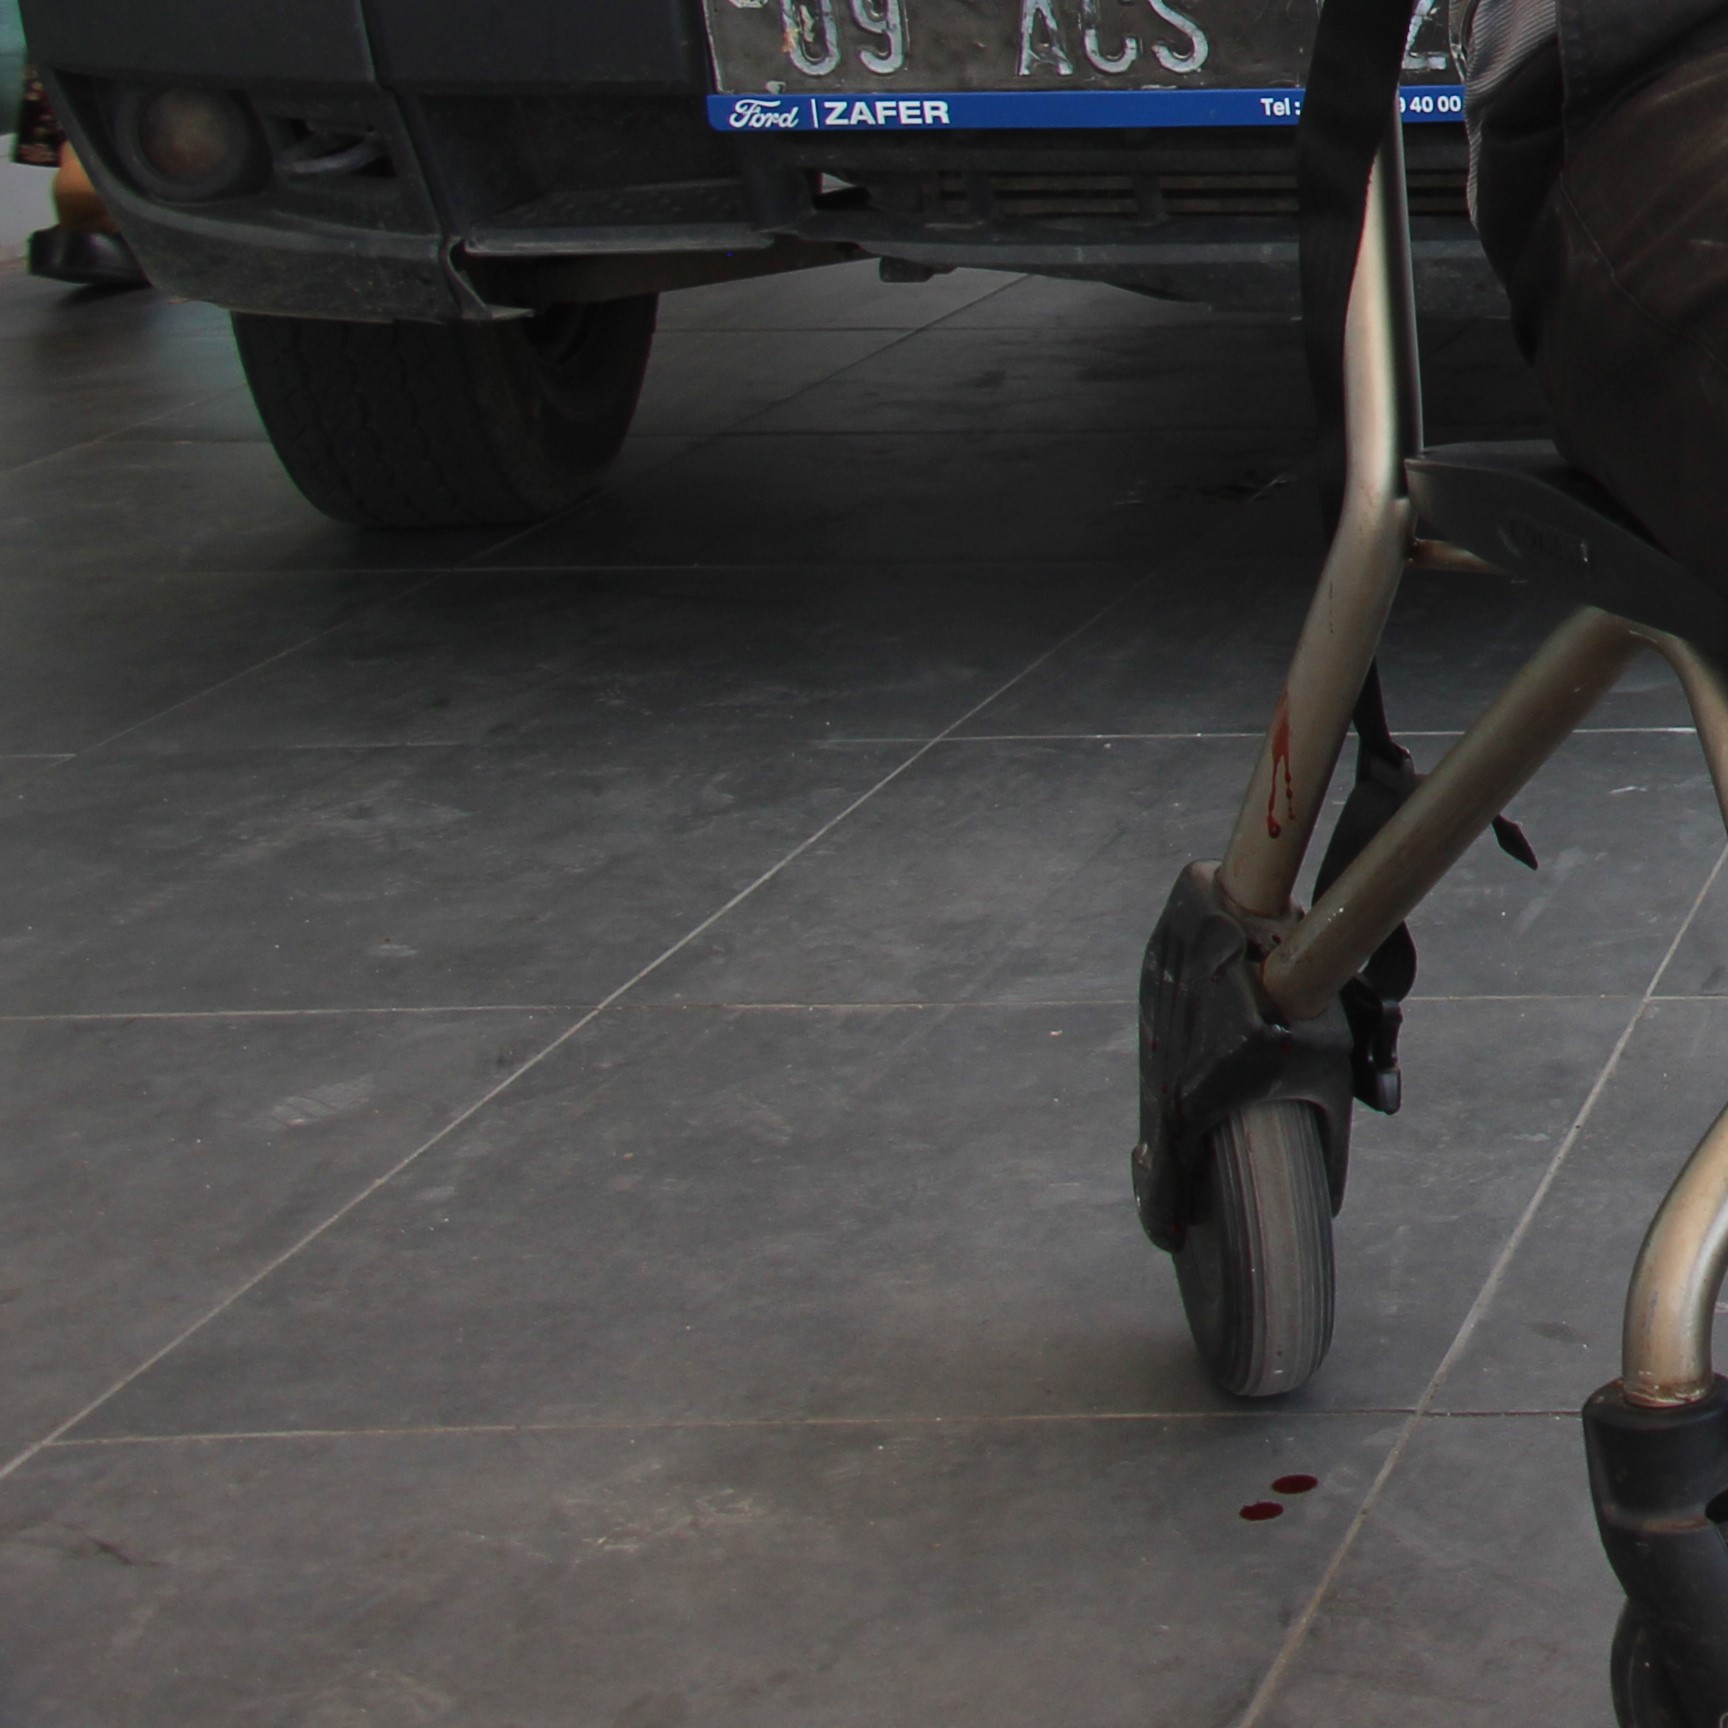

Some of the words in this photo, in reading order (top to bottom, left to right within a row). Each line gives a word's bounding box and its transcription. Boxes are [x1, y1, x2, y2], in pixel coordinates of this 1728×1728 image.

[729, 98, 799, 128] Ford
[823, 100, 950, 126] ZAFER
[1409, 96, 1434, 113] 40
[1437, 95, 1462, 113] 00
